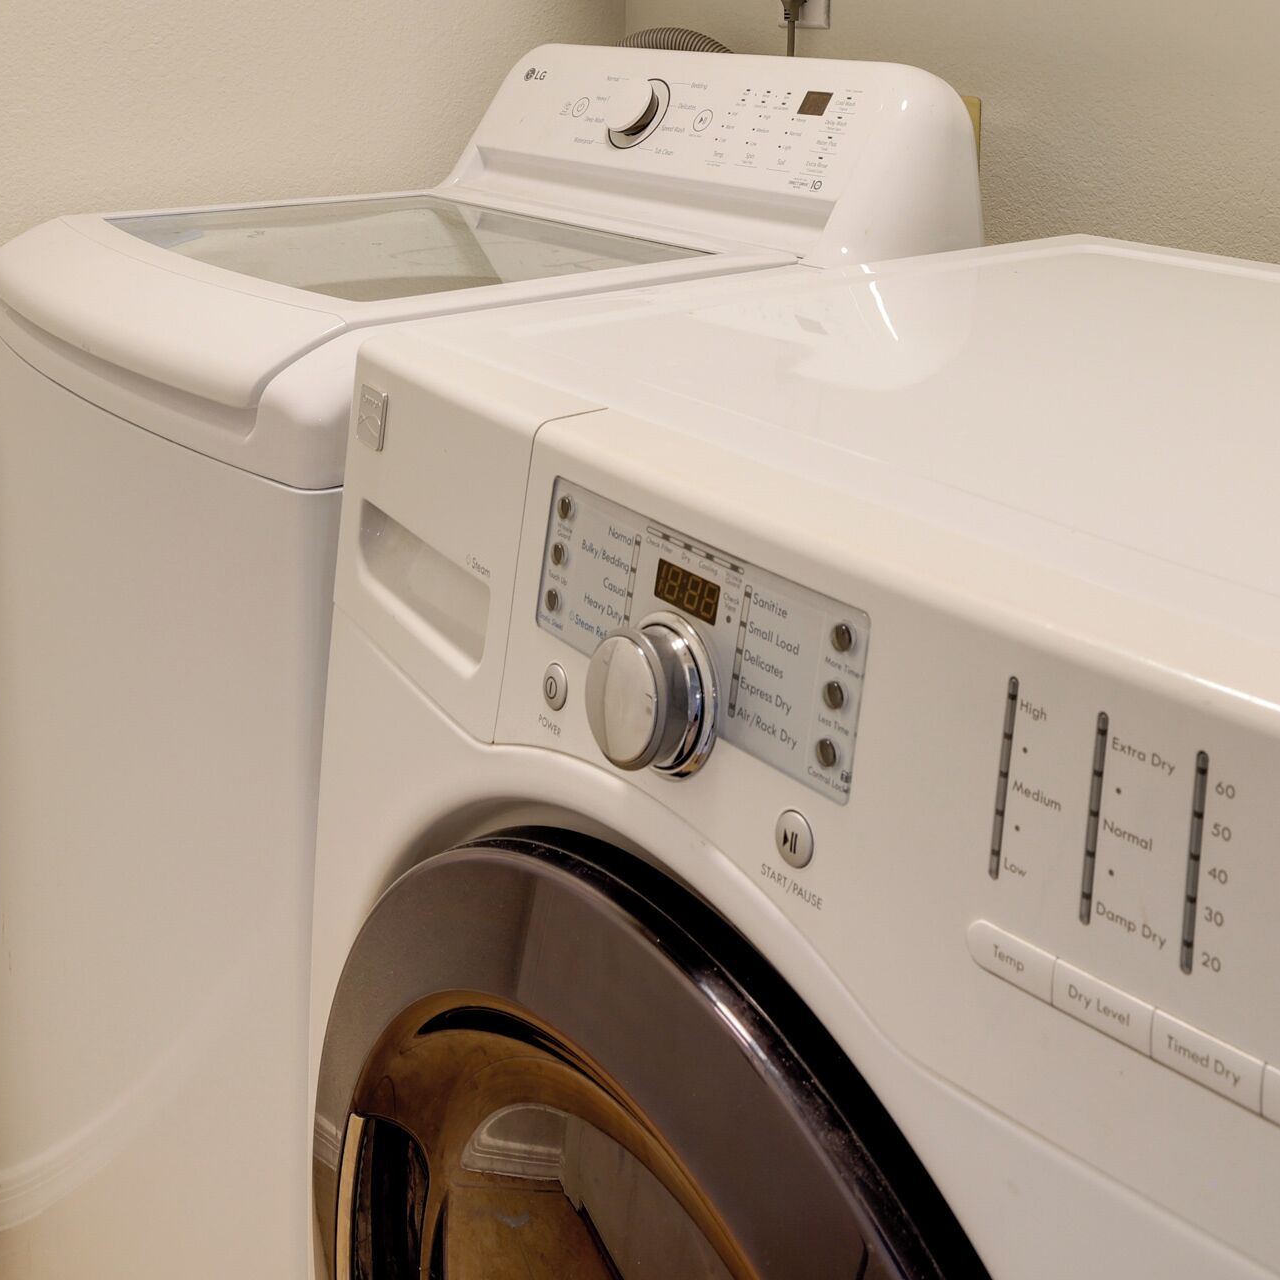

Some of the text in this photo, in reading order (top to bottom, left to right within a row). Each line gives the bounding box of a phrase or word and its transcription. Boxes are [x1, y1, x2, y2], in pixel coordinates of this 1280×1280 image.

[608, 526, 634, 546] Normal
[472, 558, 491, 578] Steam
[581, 540, 630, 575] Bulky/Bedding
[603, 577, 626, 598] Casual
[584, 593, 623, 622] Heavy Duty
[752, 593, 788, 619] Sanitize
[575, 615, 594, 634] Steam
[748, 623, 800, 656] Small Load
[743, 650, 783, 679] Delicates
[740, 677, 792, 715] Express Dry
[1019, 699, 1047, 721] High
[538, 713, 562, 738] POWER
[736, 707, 798, 750] Air/Rack Dry
[1111, 737, 1176, 777] Extra Dry
[1012, 780, 1063, 813] Medium
[1215, 782, 1235, 800] 60
[1103, 818, 1154, 852] Normal
[1212, 823, 1232, 842] 50
[1003, 857, 1027, 879] Low
[1208, 866, 1229, 886] 40
[761, 863, 823, 911] START/PAUSE
[1096, 900, 1168, 951] Damp Dry
[1204, 908, 1224, 928] 30
[992, 943, 1026, 974] Temp
[1201, 952, 1222, 973] 20
[1067, 984, 1132, 1028] Dry Level
[1167, 1034, 1242, 1087] Timed Dry
